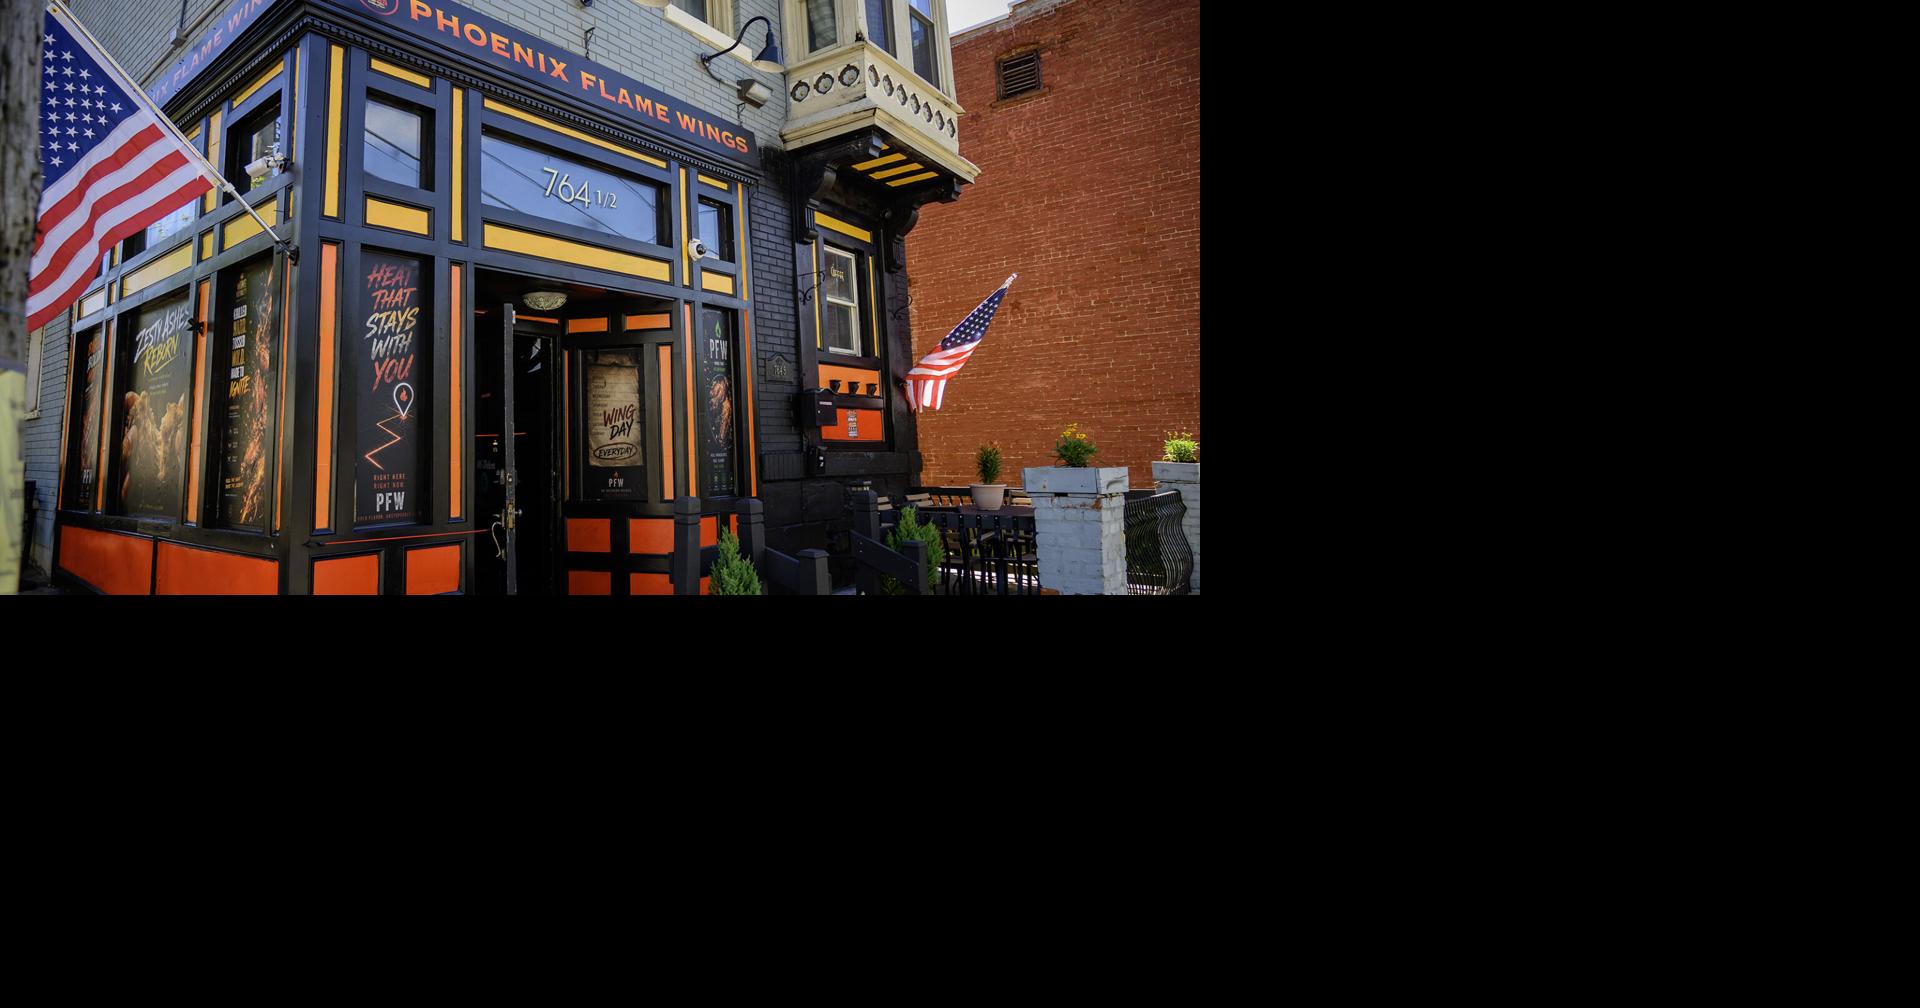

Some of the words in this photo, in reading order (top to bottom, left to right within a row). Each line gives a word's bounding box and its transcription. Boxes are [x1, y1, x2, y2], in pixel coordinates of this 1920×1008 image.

[172, 28, 223, 88] FLAME
[228, 0, 263, 33] WIN
[410, 0, 570, 83] PHOENIX
[580, 71, 670, 123] FLAME
[677, 113, 749, 153] WINGS
[543, 168, 591, 208] 764
[595, 190, 618, 209] 1/2
[367, 263, 412, 288] HEAT
[371, 287, 417, 312] THAT
[364, 306, 420, 339] STAYS
[133, 318, 163, 364] ZESTY
[371, 331, 413, 360] WITH
[709, 338, 728, 360] PFW
[372, 353, 414, 393] YOU
[229, 375, 251, 399] IGNITE
[603, 404, 636, 427] WING
[609, 419, 634, 440] DAY
[598, 446, 634, 458] EVERYDAY
[608, 478, 624, 488] PFW
[376, 491, 405, 512] PFW
